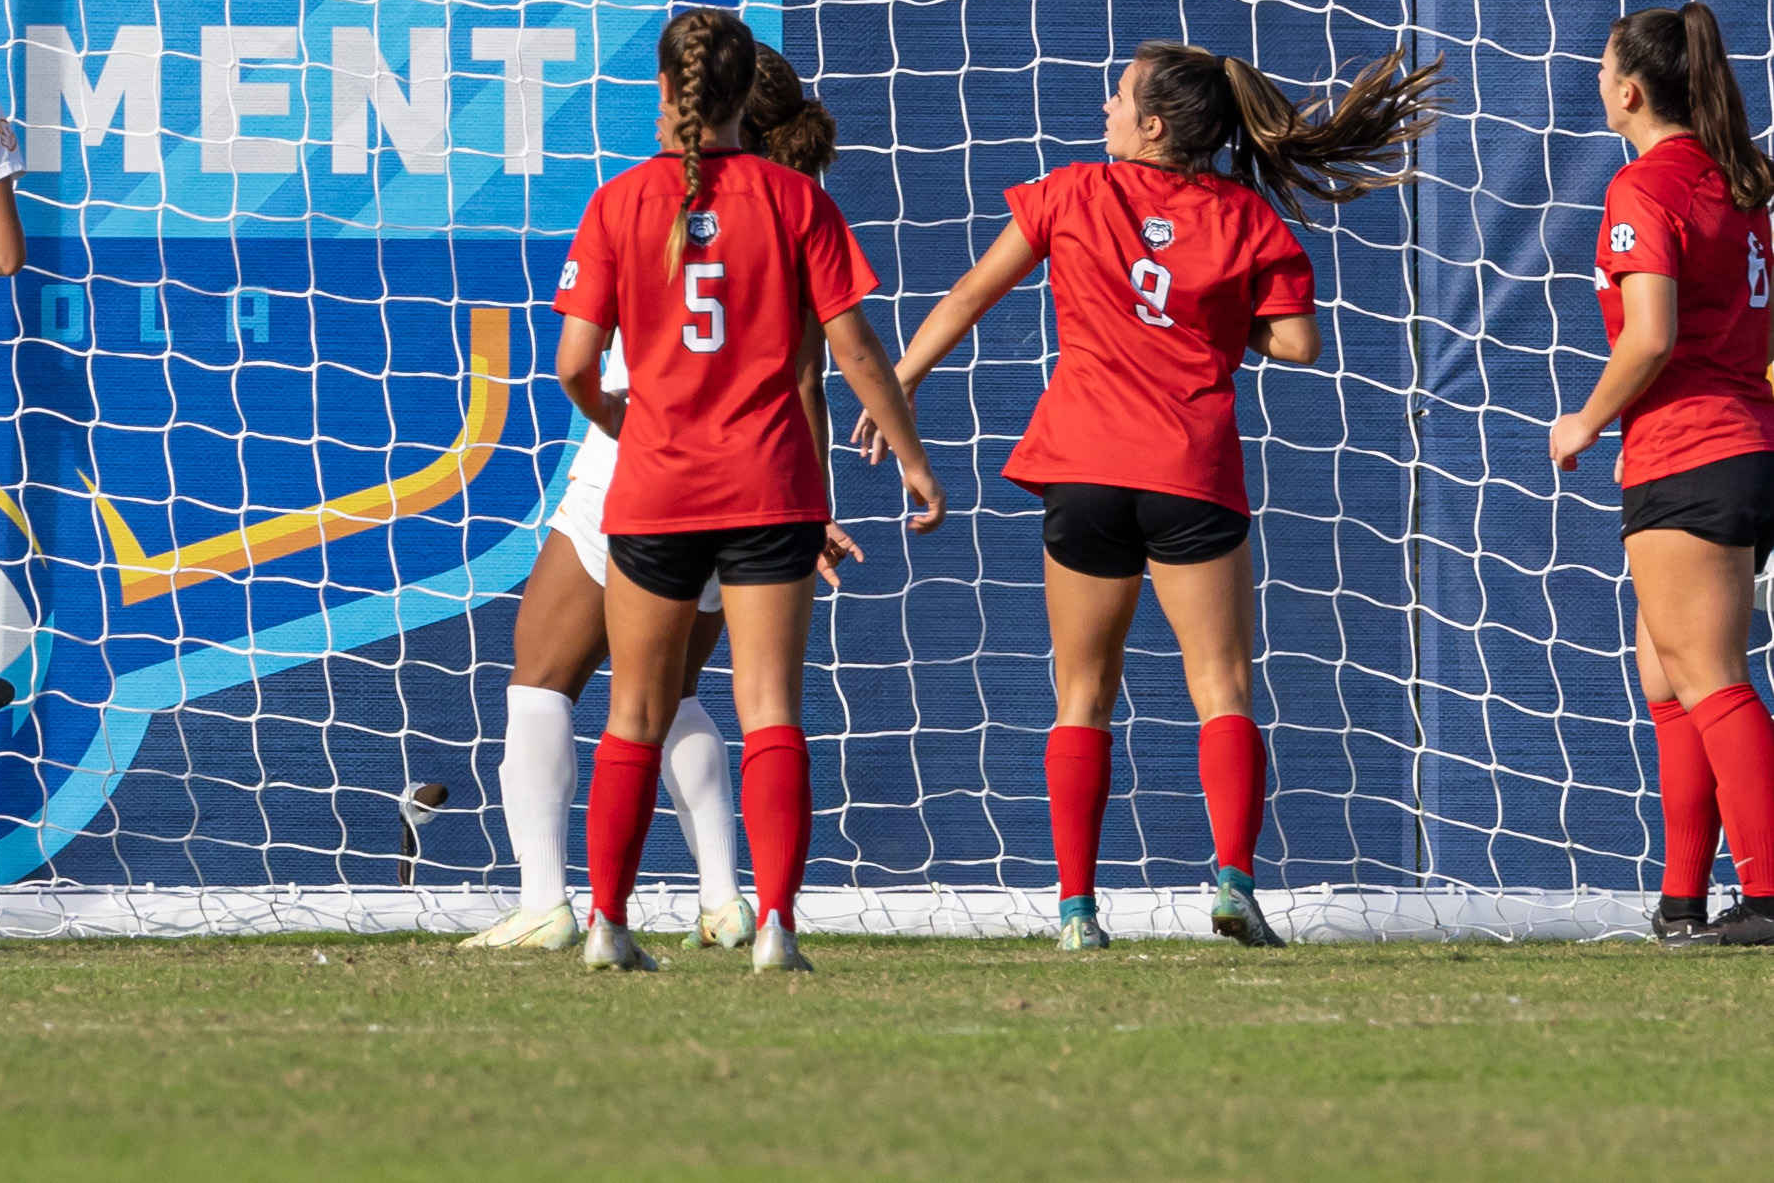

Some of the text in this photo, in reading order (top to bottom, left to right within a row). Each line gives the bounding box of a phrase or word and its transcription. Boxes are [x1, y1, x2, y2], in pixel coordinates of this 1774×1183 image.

[1610, 223, 1636, 253] SEC
[682, 261, 728, 354] 5
[1129, 257, 1175, 328] 9
